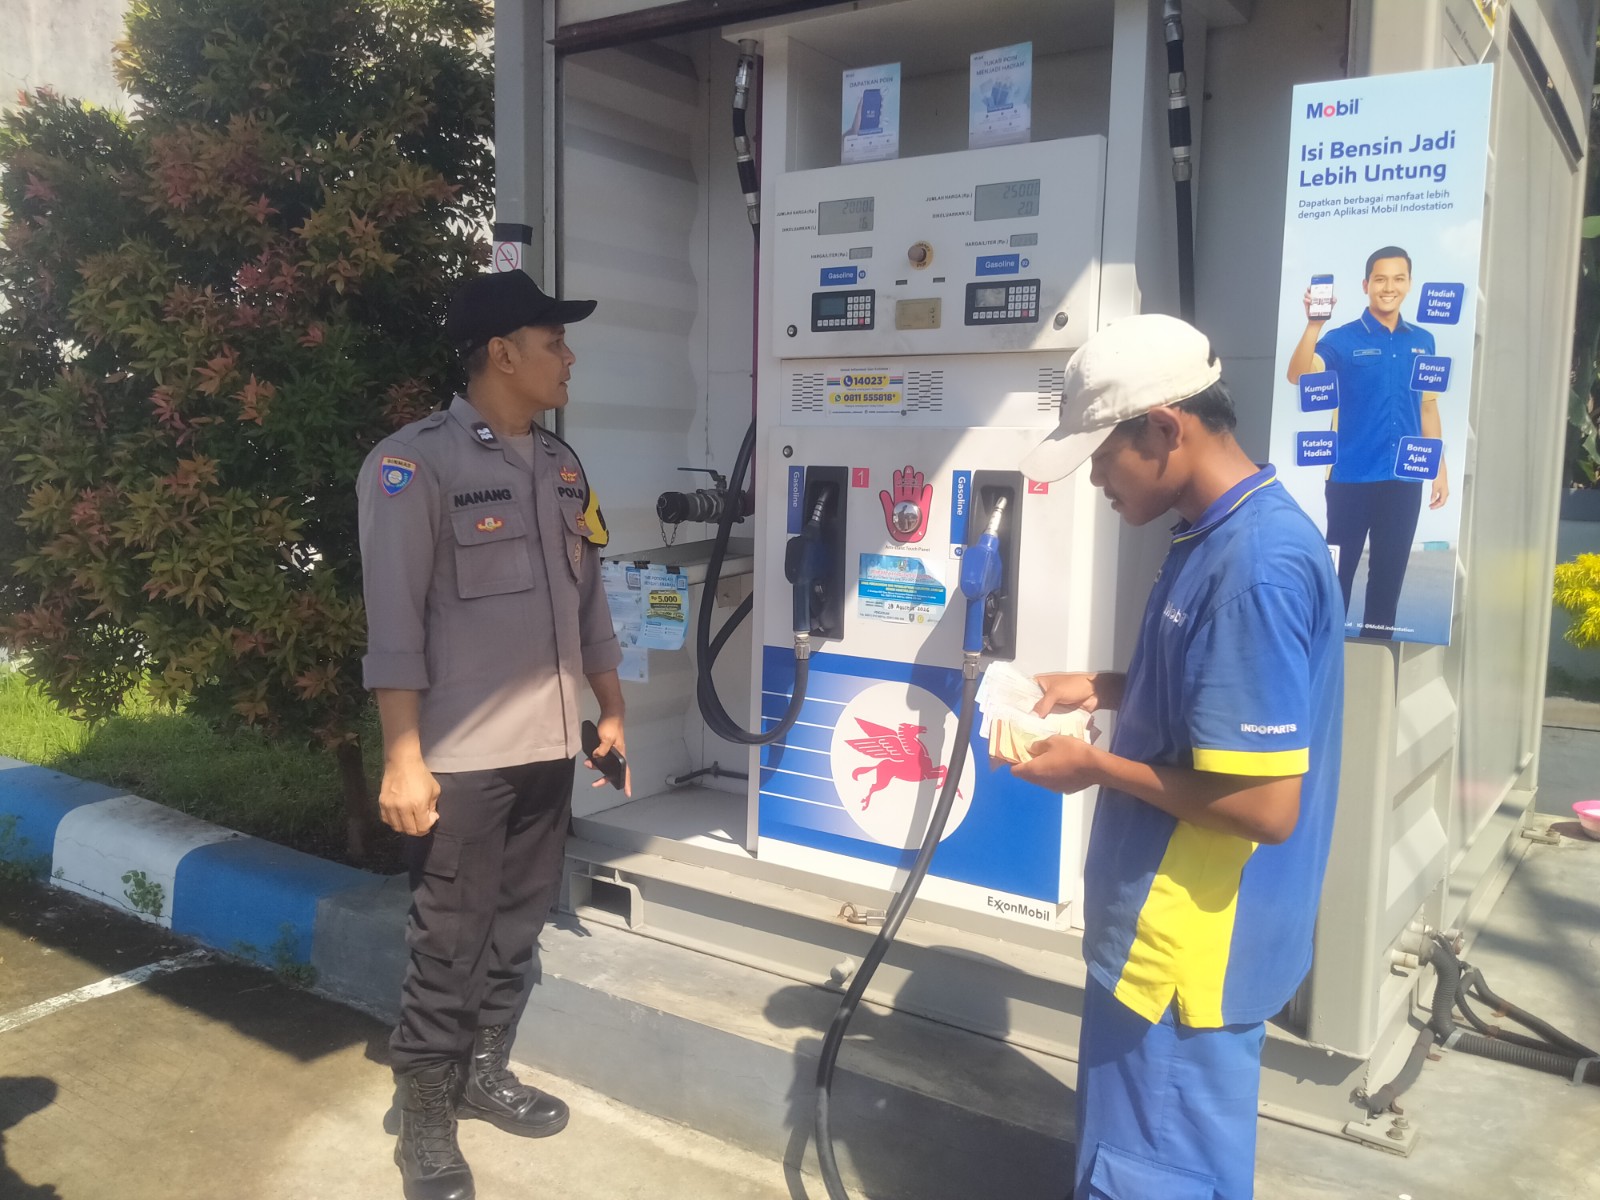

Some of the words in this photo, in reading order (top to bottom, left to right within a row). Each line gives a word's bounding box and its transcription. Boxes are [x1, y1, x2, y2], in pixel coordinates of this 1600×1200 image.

[849, 79, 879, 88] DAPATKAN
[1306, 98, 1360, 119] Mobil
[1301, 142, 1323, 162] Isi
[1330, 136, 1402, 159] Bensin
[1408, 130, 1456, 153] Jadi
[1299, 166, 1357, 187] Lebih
[1365, 163, 1447, 183] Untung
[1298, 197, 1341, 210] Dapatkan
[1343, 194, 1384, 207] berbagai
[1386, 191, 1424, 202] manfaat
[1426, 190, 1450, 199] lebih
[1298, 210, 1331, 220] dengan
[1333, 206, 1369, 218] Aplikasi
[1371, 204, 1398, 214] Mobil
[1400, 201, 1454, 212] Indostation
[985, 260, 1015, 269] Gasoline
[828, 271, 854, 280] Gasoline
[1427, 289, 1455, 298] Hadiah
[1428, 300, 1452, 309] Ulang
[1426, 309, 1450, 317] Tahun
[1419, 362, 1445, 372] Bonus
[1418, 373, 1442, 383] Login
[1304, 382, 1334, 393] Kumpul
[843, 394, 862, 402] 0811
[1311, 394, 1329, 402] Poin
[1302, 439, 1333, 448] Katalog
[1407, 443, 1432, 453] Bonus
[1303, 449, 1332, 458] Hadiah
[1408, 454, 1427, 463] Ajak
[1403, 463, 1429, 473] Teman
[857, 470, 864, 486] 1
[792, 471, 800, 508] Gasoline
[454, 489, 512, 507] NANANG
[956, 476, 966, 516] Gasoline
[657, 595, 678, 603] 5.000
[987, 895, 1050, 922] ExxonMobil
